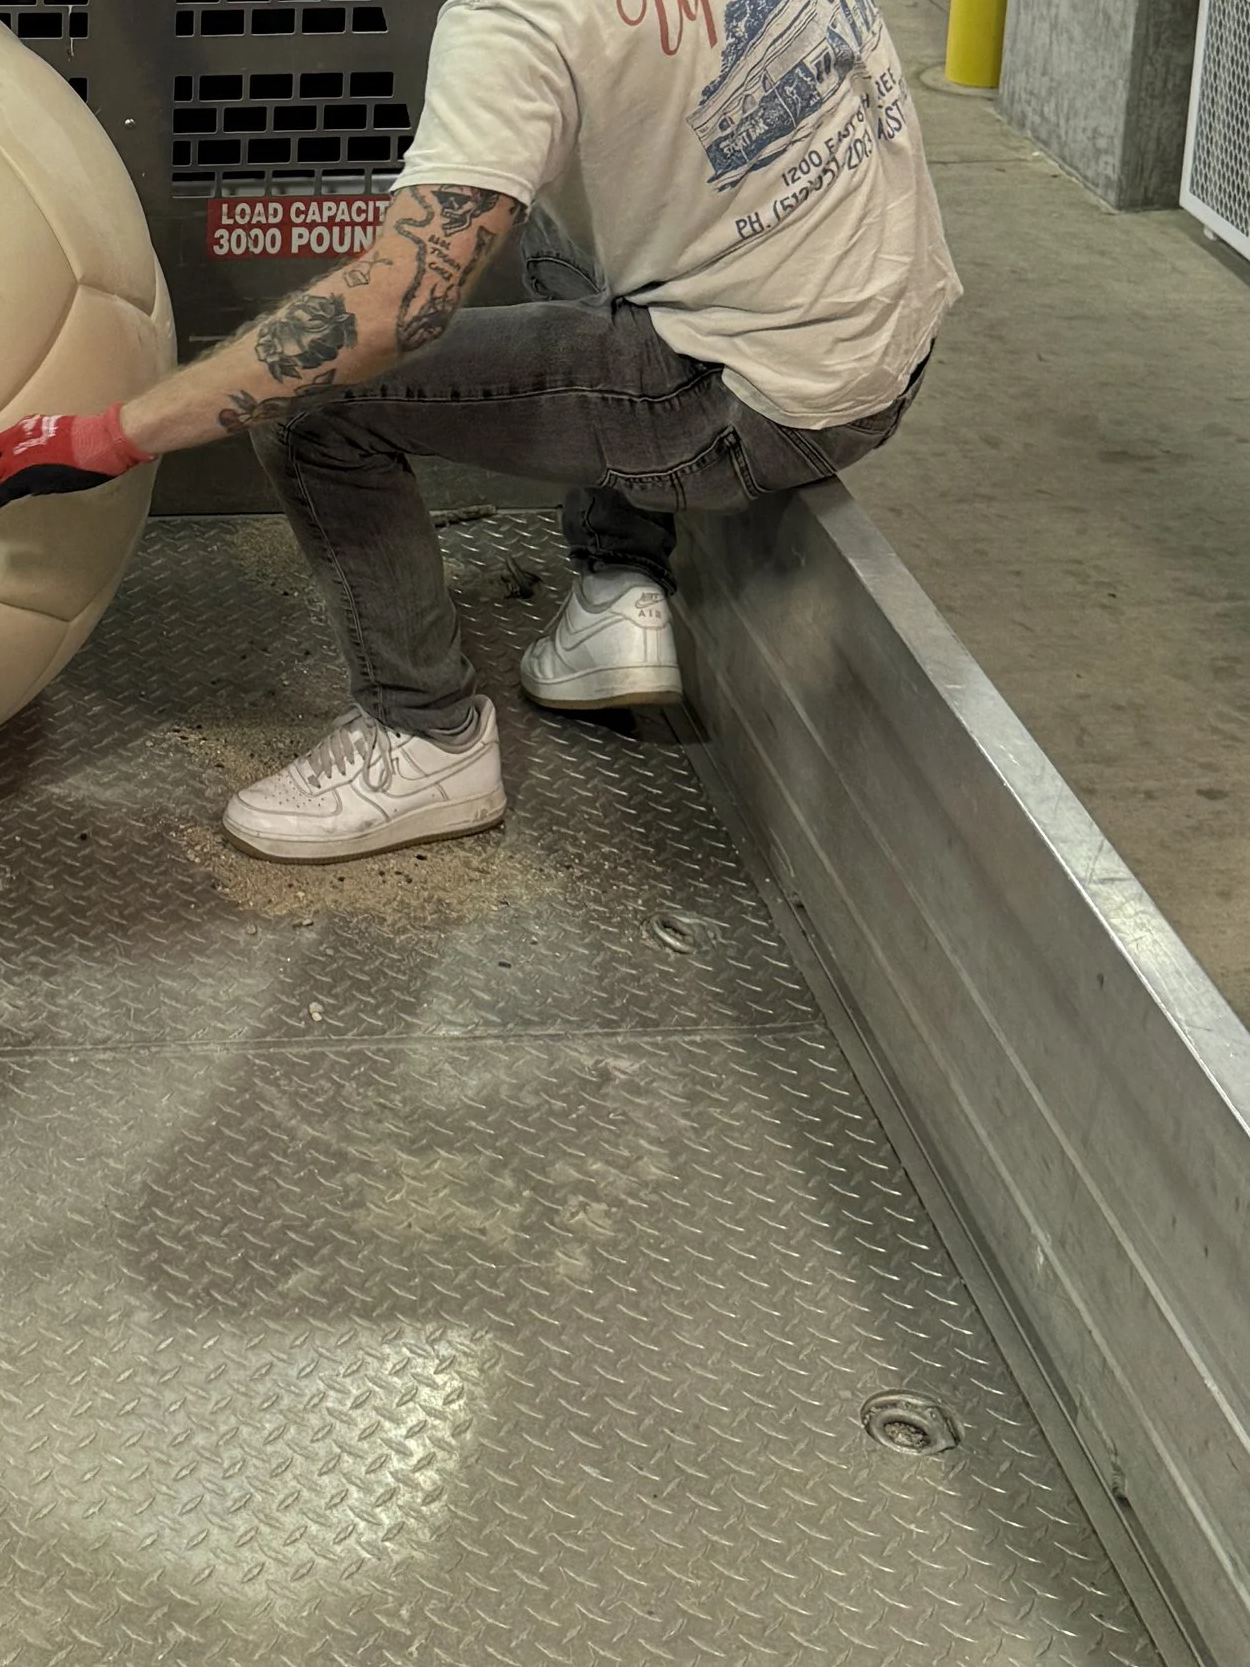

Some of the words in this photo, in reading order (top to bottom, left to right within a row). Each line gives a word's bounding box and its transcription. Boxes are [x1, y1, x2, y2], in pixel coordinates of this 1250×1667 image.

[781, 149, 823, 187] 1200
[220, 201, 284, 225] LOAD
[212, 227, 282, 257] 3000
[290, 224, 383, 255] POUN
